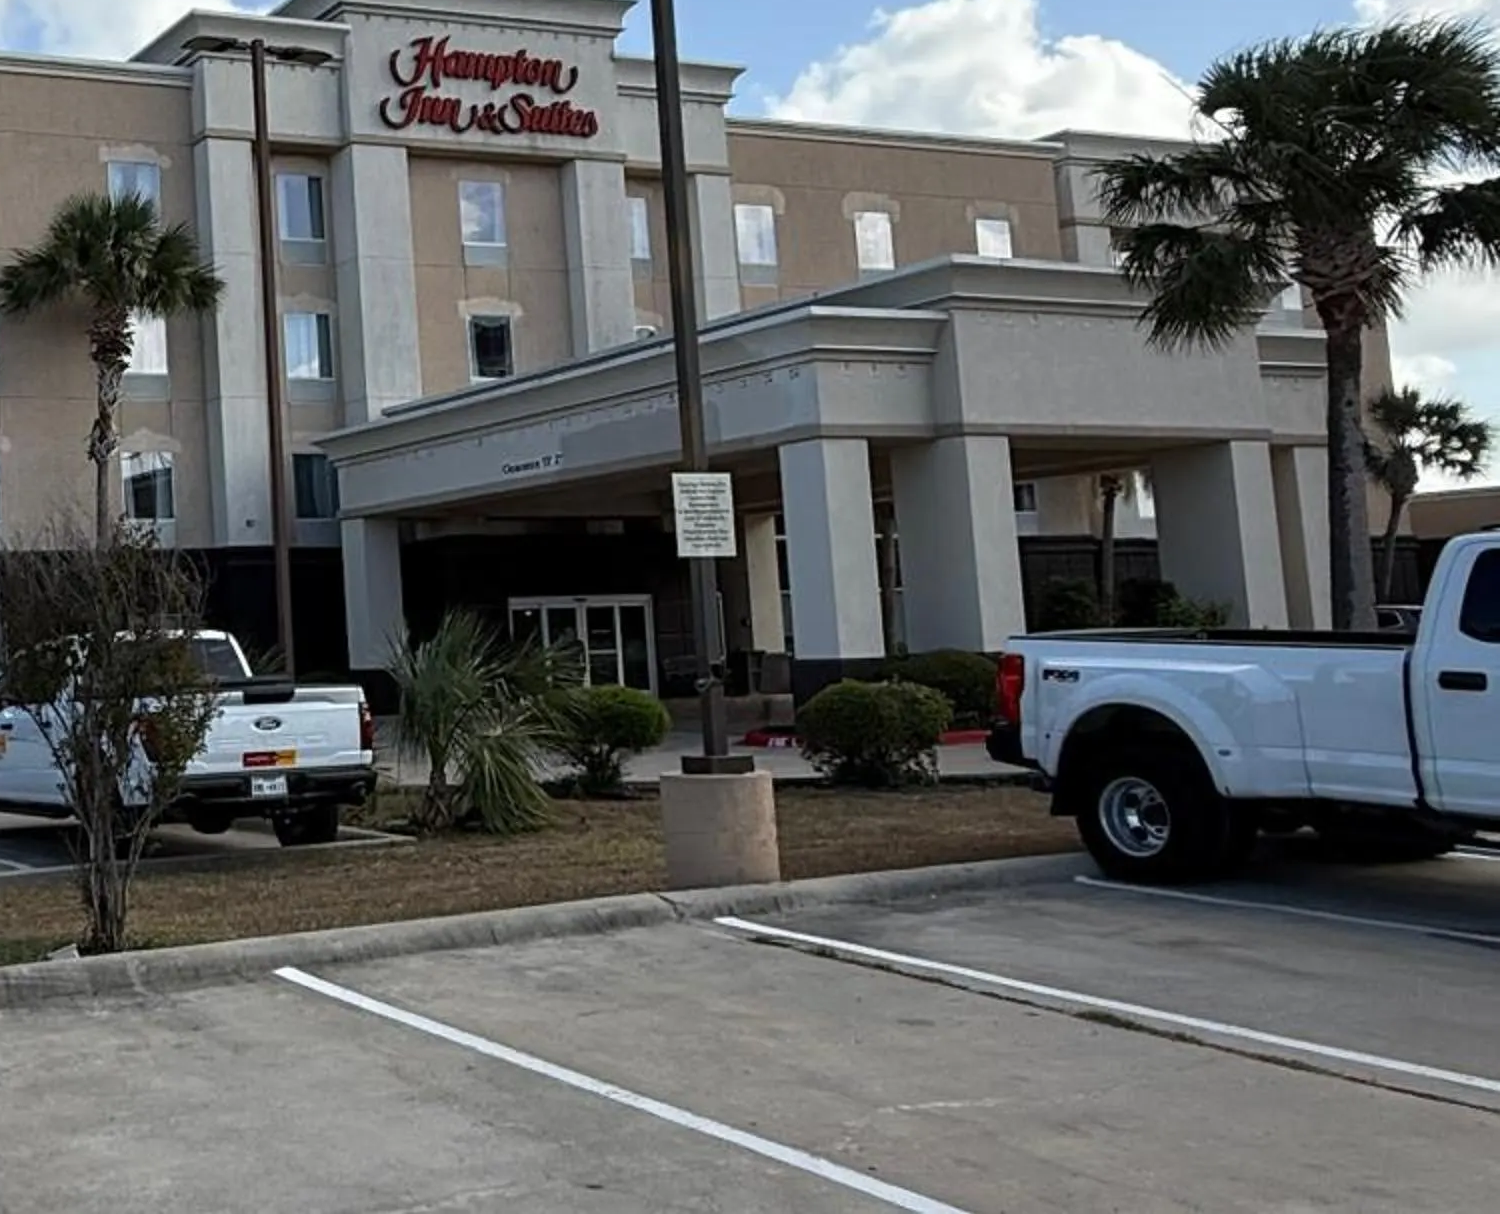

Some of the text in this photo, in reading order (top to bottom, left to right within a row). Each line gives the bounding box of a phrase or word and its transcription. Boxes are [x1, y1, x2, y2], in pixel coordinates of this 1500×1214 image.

[389, 35, 579, 94] Hampton
[379, 86, 478, 134] Inn
[499, 93, 599, 138] Suites
